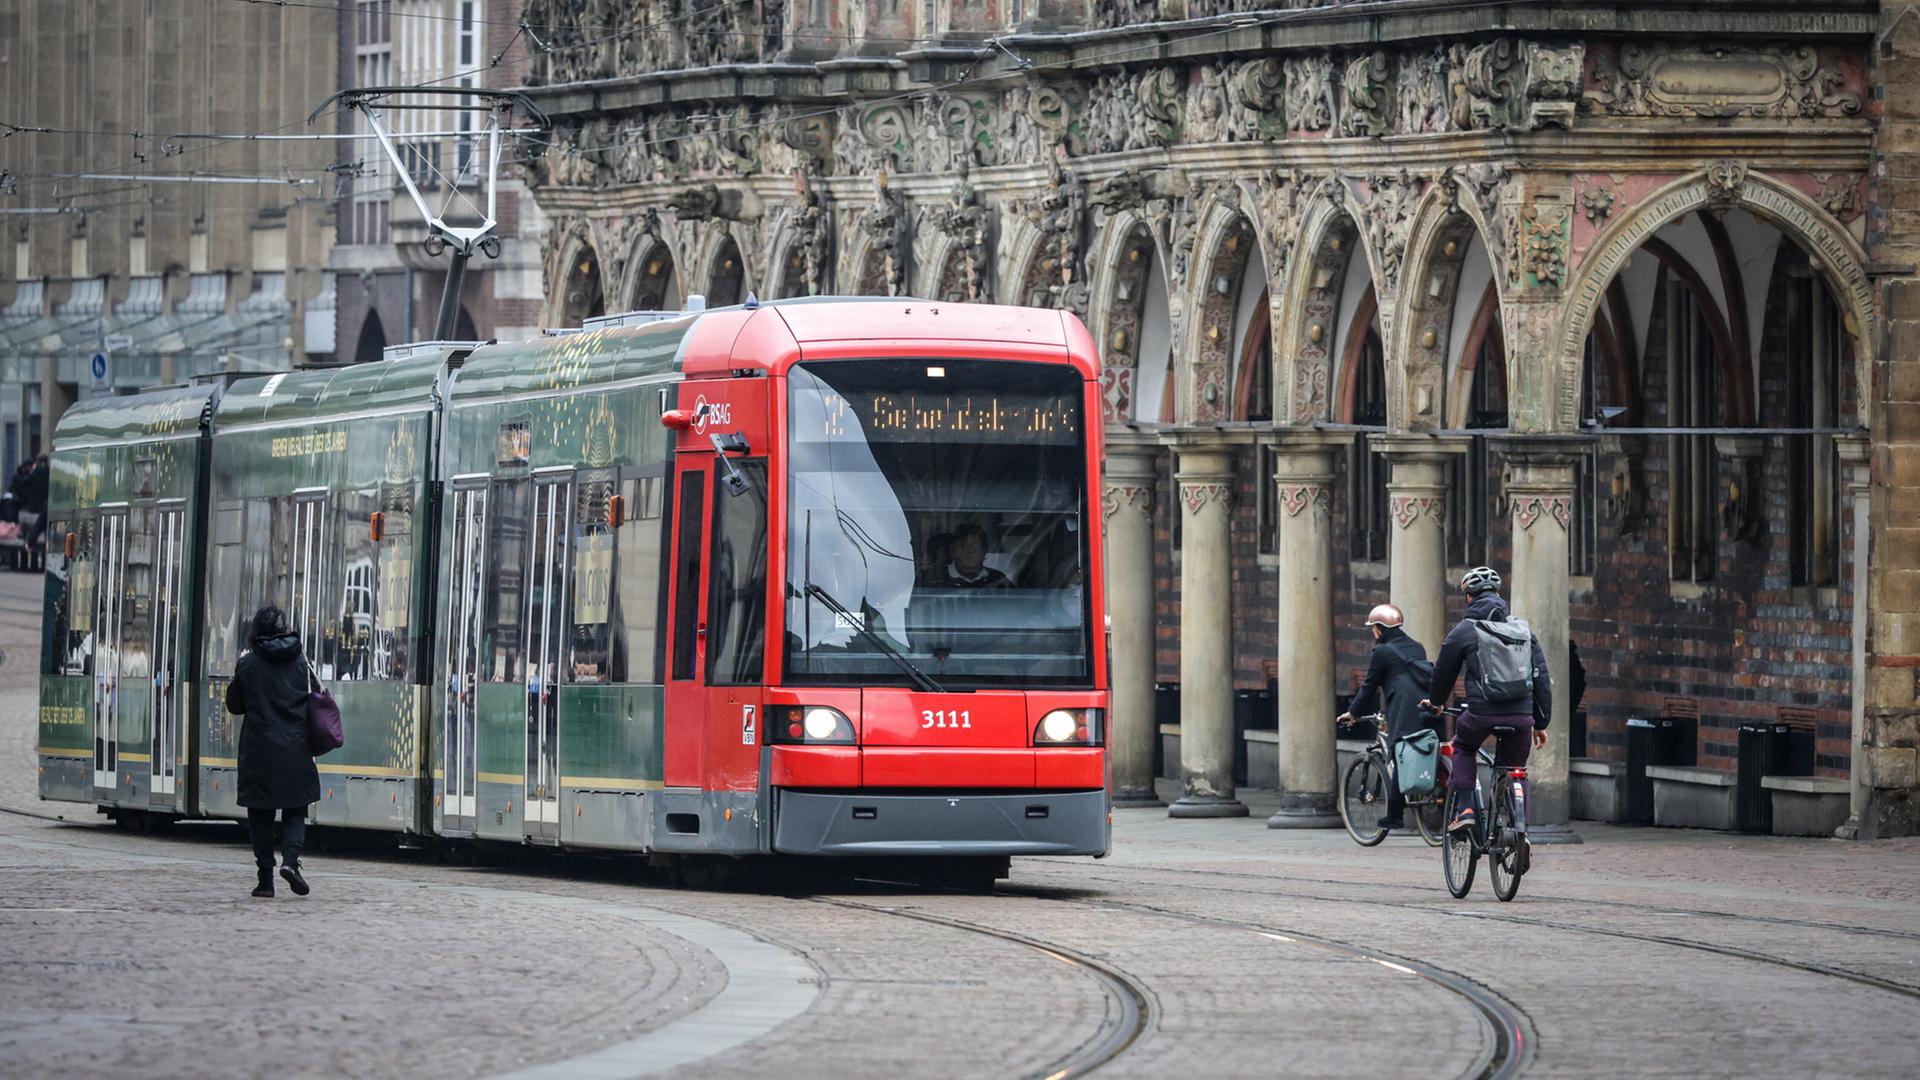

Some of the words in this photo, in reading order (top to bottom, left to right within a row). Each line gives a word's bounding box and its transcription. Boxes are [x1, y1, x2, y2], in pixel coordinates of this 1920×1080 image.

[710, 403, 731, 425] BSAG
[873, 396, 1075, 432] Sebaldsbck
[921, 710, 972, 729] 3111
